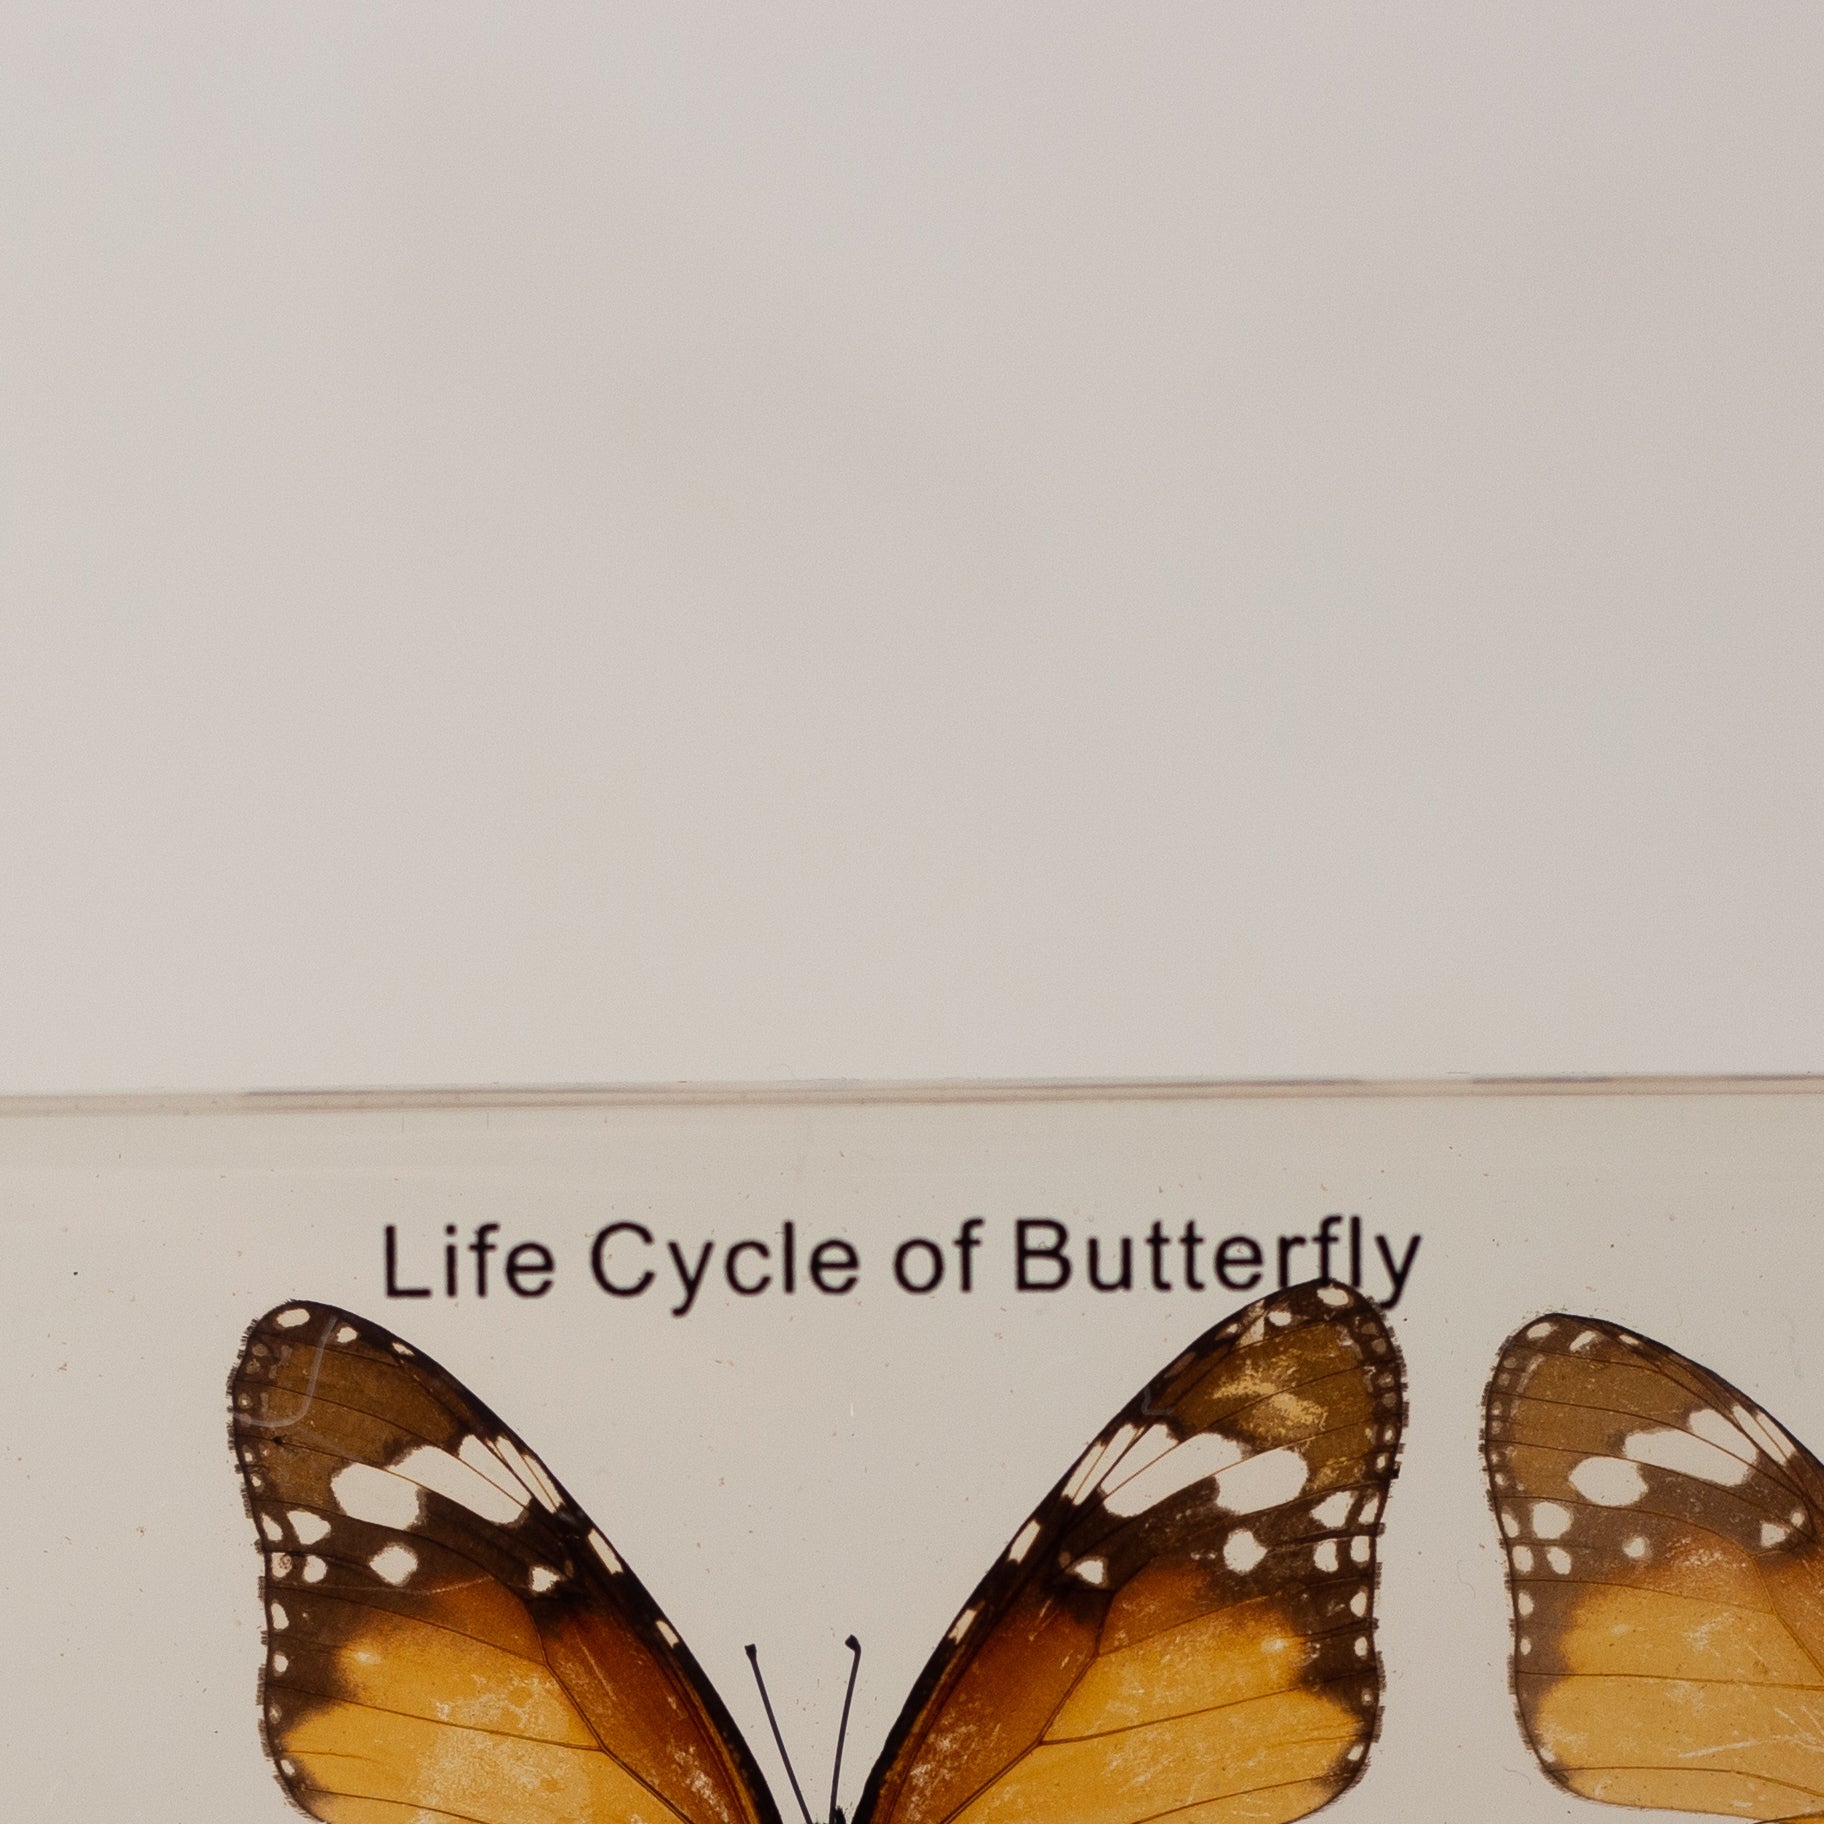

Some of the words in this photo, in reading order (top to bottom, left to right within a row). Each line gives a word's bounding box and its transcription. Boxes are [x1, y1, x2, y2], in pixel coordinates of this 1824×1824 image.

[384, 1222, 557, 1300] Life
[589, 1219, 861, 1318] Cycle
[892, 1216, 985, 1295] of
[1014, 1213, 1423, 1308] Butterfly
